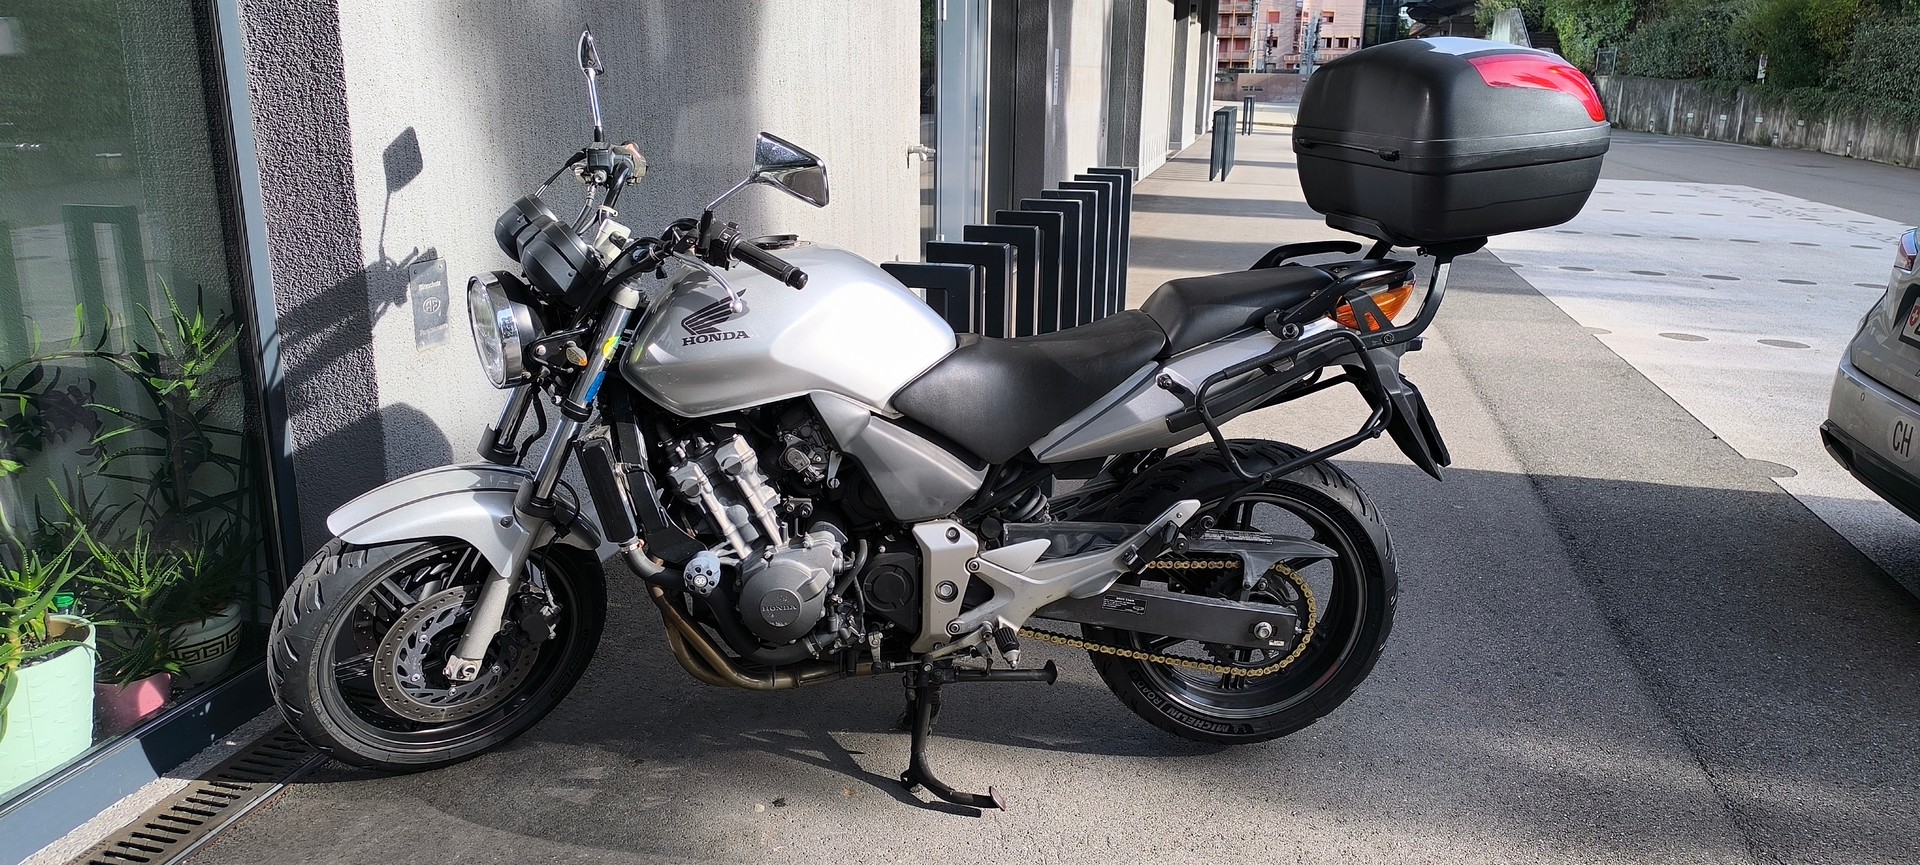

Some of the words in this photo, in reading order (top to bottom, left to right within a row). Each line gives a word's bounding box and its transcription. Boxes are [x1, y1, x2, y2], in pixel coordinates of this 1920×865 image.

[682, 331, 750, 346] HONDA
[1893, 420, 1914, 457] CH
[1137, 681, 1162, 705] ROAD
[1166, 707, 1229, 733] MICHELIN
